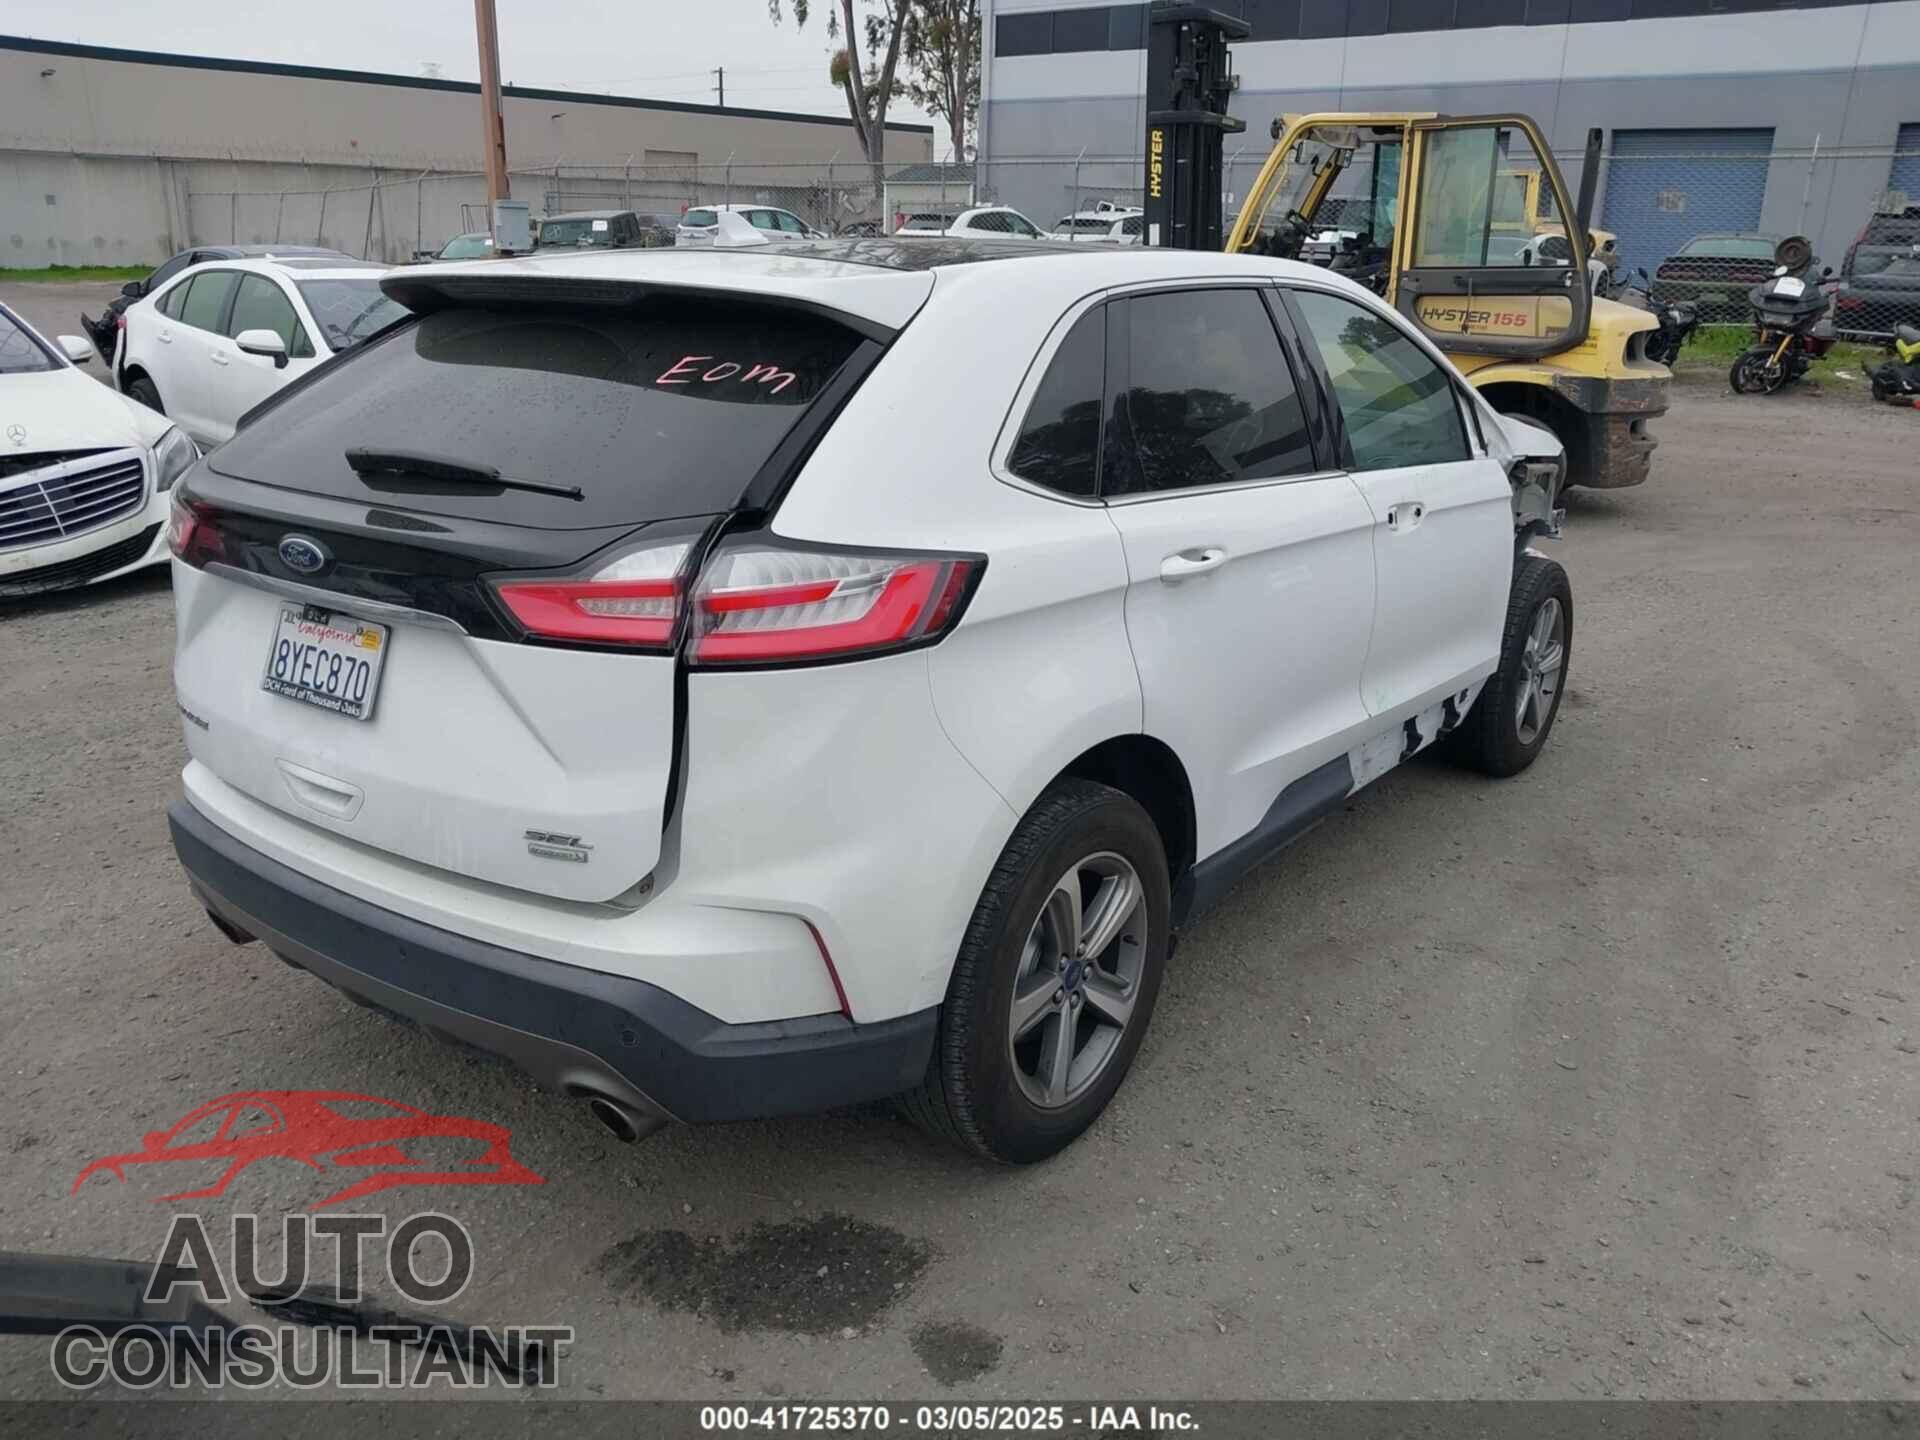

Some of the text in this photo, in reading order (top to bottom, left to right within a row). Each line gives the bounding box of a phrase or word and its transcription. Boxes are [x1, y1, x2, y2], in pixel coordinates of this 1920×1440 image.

[1150, 130, 1163, 198] HYSTER
[1422, 308, 1491, 324] HYSTER
[1492, 312, 1528, 327] 155
[274, 639, 371, 702] 8YEC870
